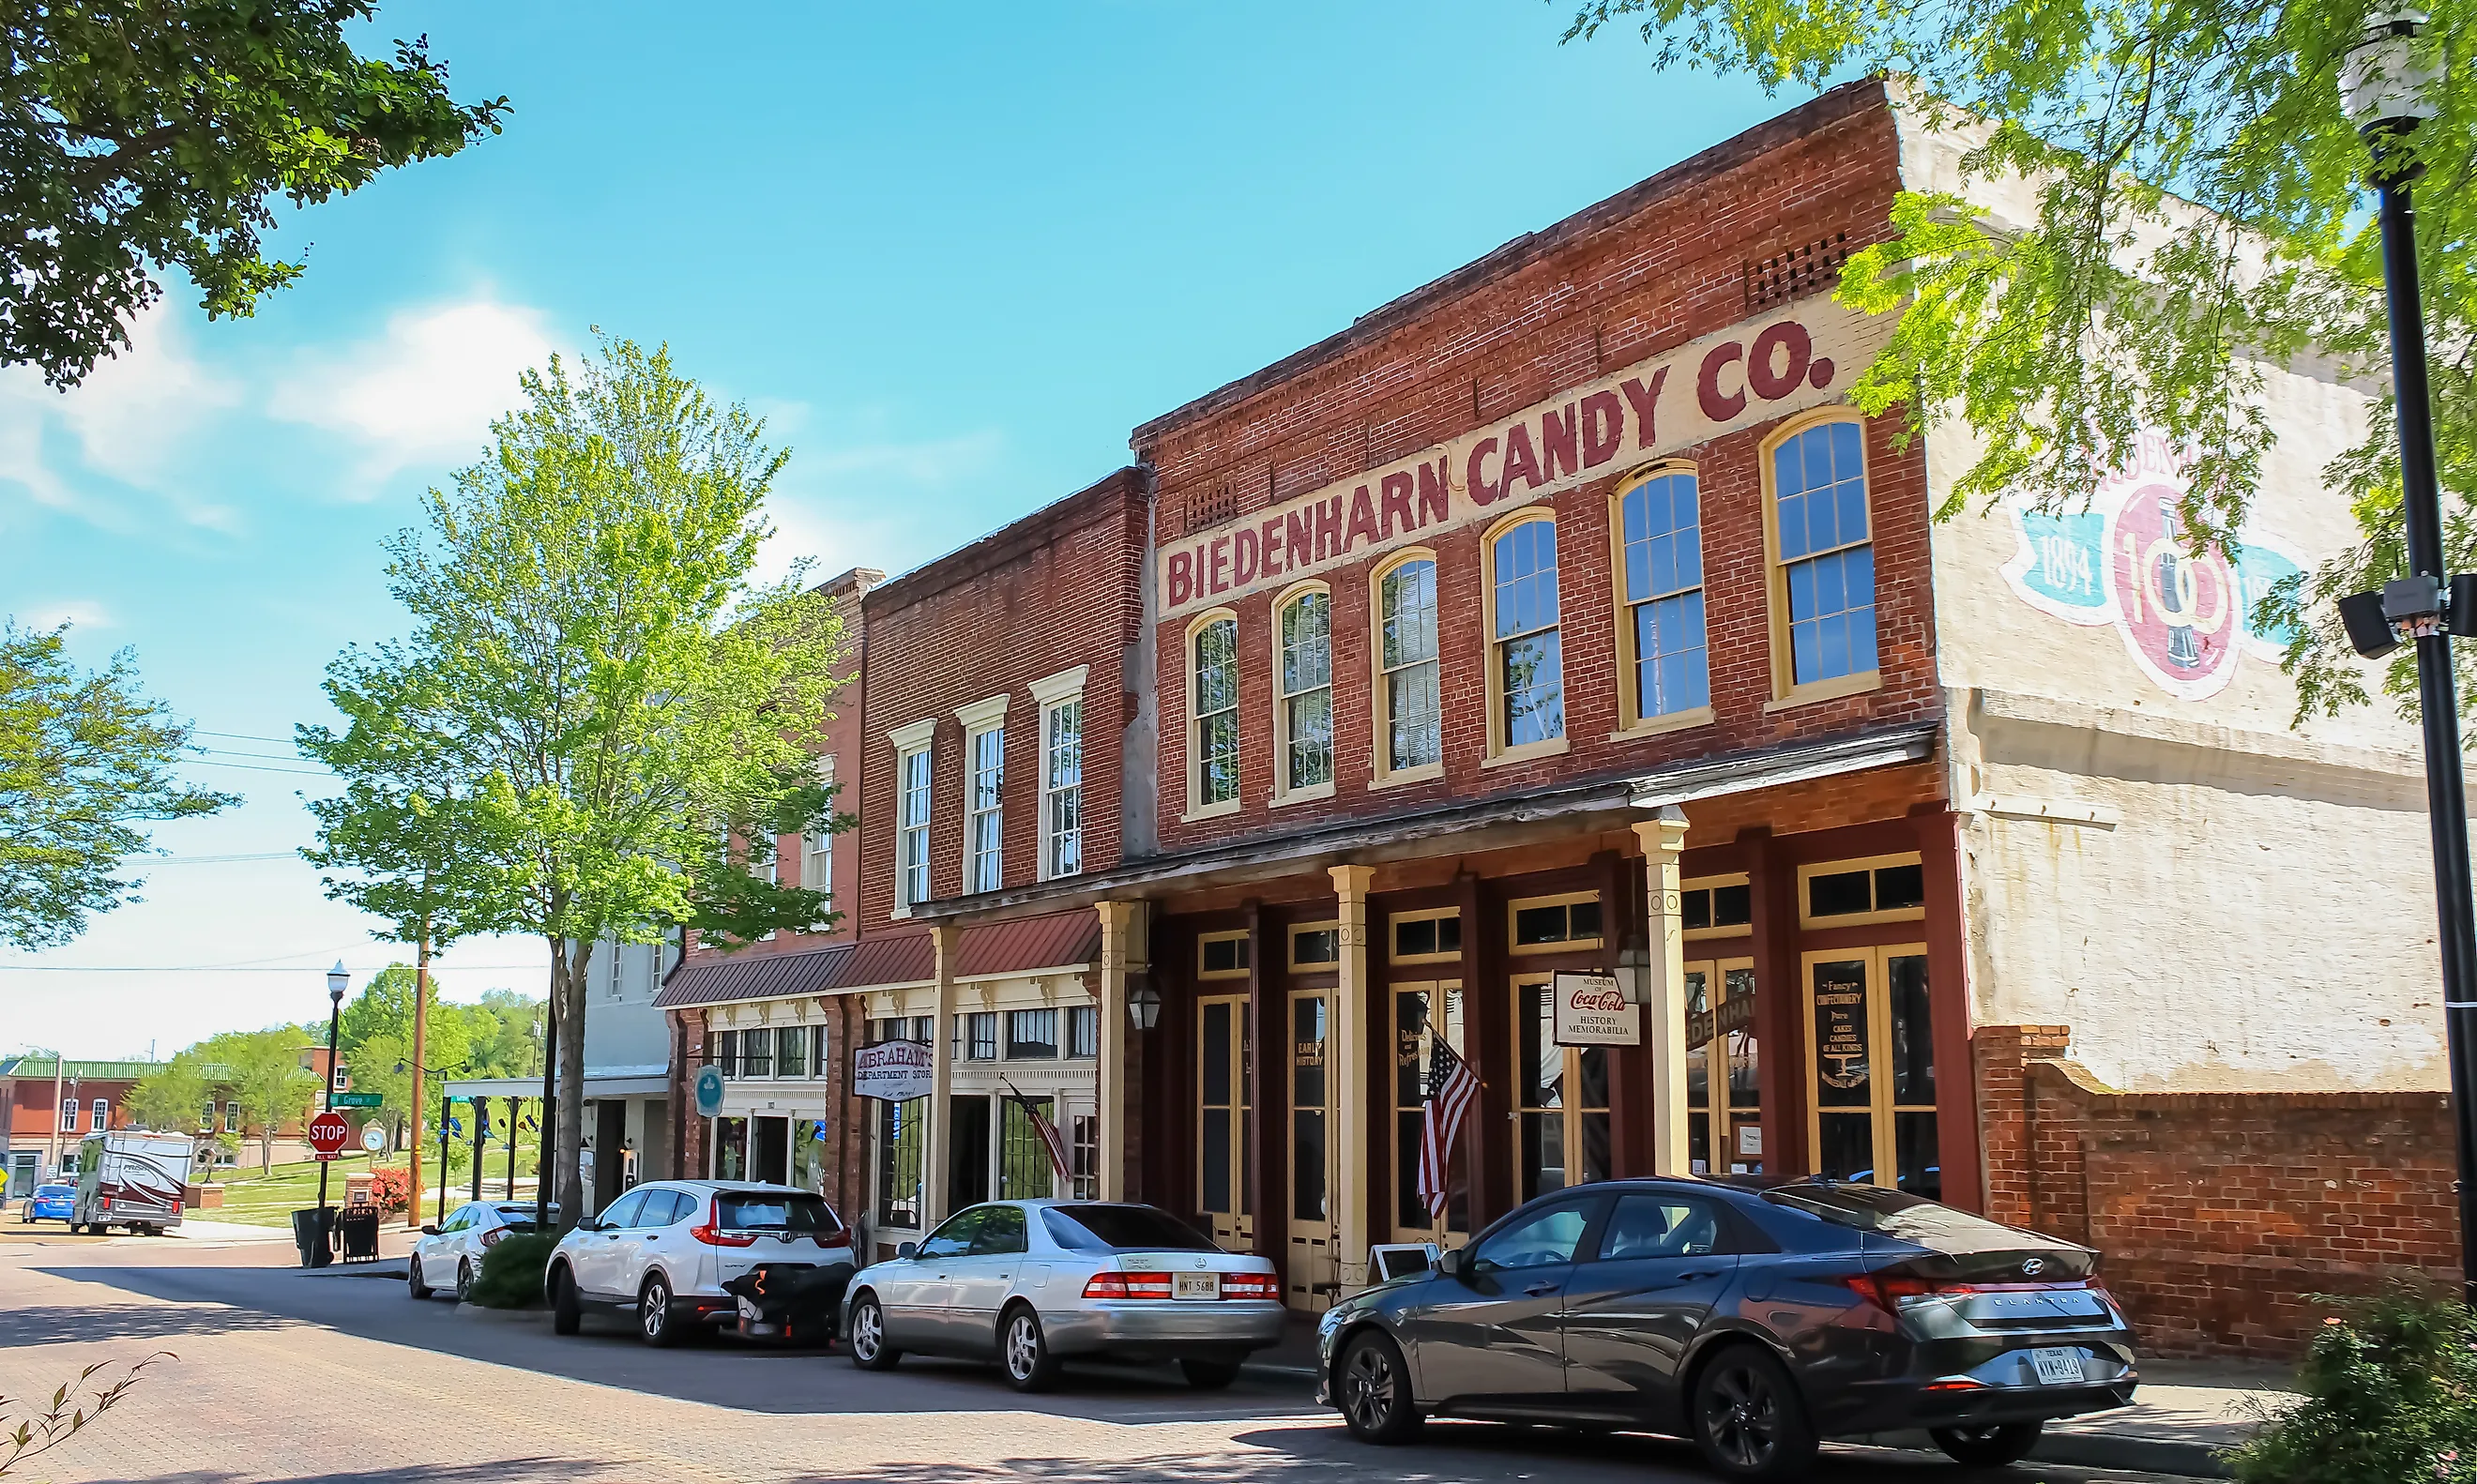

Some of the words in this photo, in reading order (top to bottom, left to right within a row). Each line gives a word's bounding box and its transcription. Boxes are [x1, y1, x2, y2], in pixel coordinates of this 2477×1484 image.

[1168, 455, 1450, 608] BIEDENHARN
[1466, 364, 1671, 507] CANDY
[1696, 320, 1835, 423] CO.
[2039, 534, 2094, 597] 1894
[2122, 531, 2231, 635] 100
[1828, 980, 1851, 992] Fancy
[1571, 989, 1626, 1011] Coca-Cola
[1580, 1015, 1618, 1025] HISTORY
[1568, 1024, 1629, 1036] MEMORABILIA
[1298, 1041, 1323, 1053] EARLY
[857, 1069, 908, 1081] DEPARTMENT
[343, 1095, 363, 1105] Grove
[311, 1125, 345, 1141] STOP
[1994, 1297, 2080, 1307] ELANTRA
[2045, 1349, 2063, 1357] TEXAS
